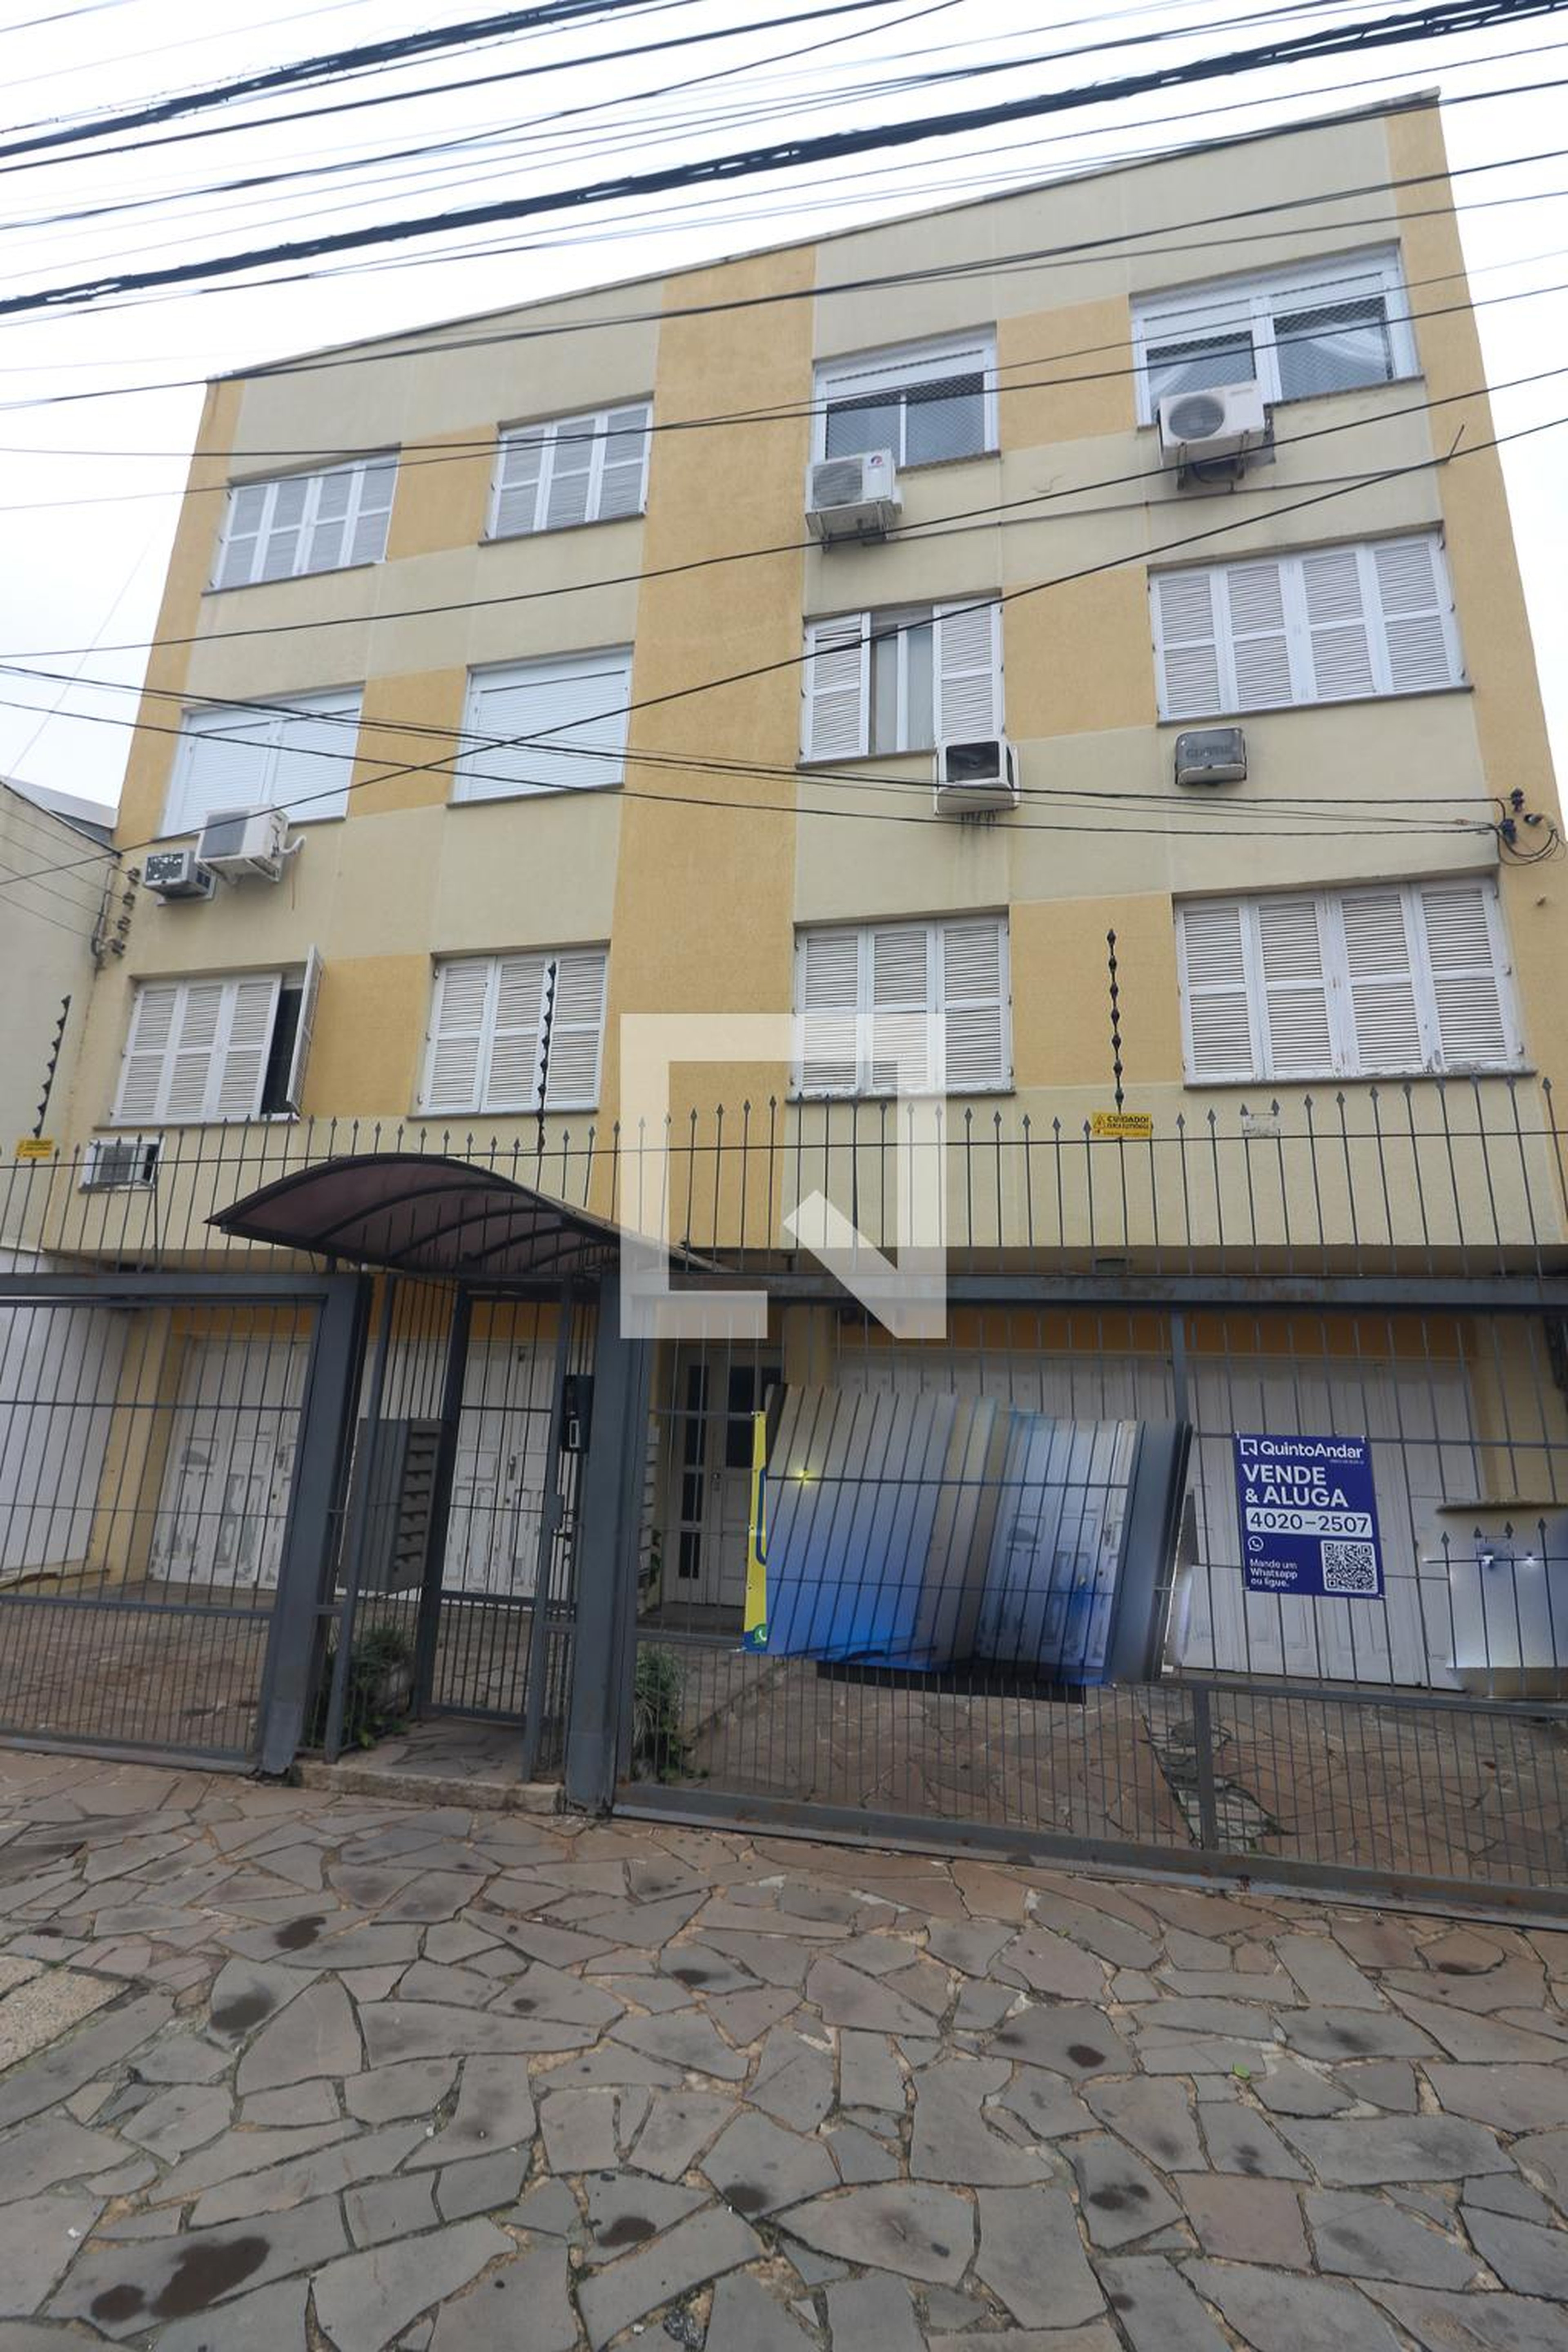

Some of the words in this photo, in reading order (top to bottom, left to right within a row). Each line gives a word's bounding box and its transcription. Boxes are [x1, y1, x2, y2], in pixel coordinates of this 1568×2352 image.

[1260, 1441, 1363, 1458] QuintoAndar
[1242, 1464, 1327, 1485] VENDE
[1245, 1488, 1259, 1503] &
[1263, 1486, 1349, 1508] ALUGA
[1250, 1512, 1369, 1533] 4020-2507
